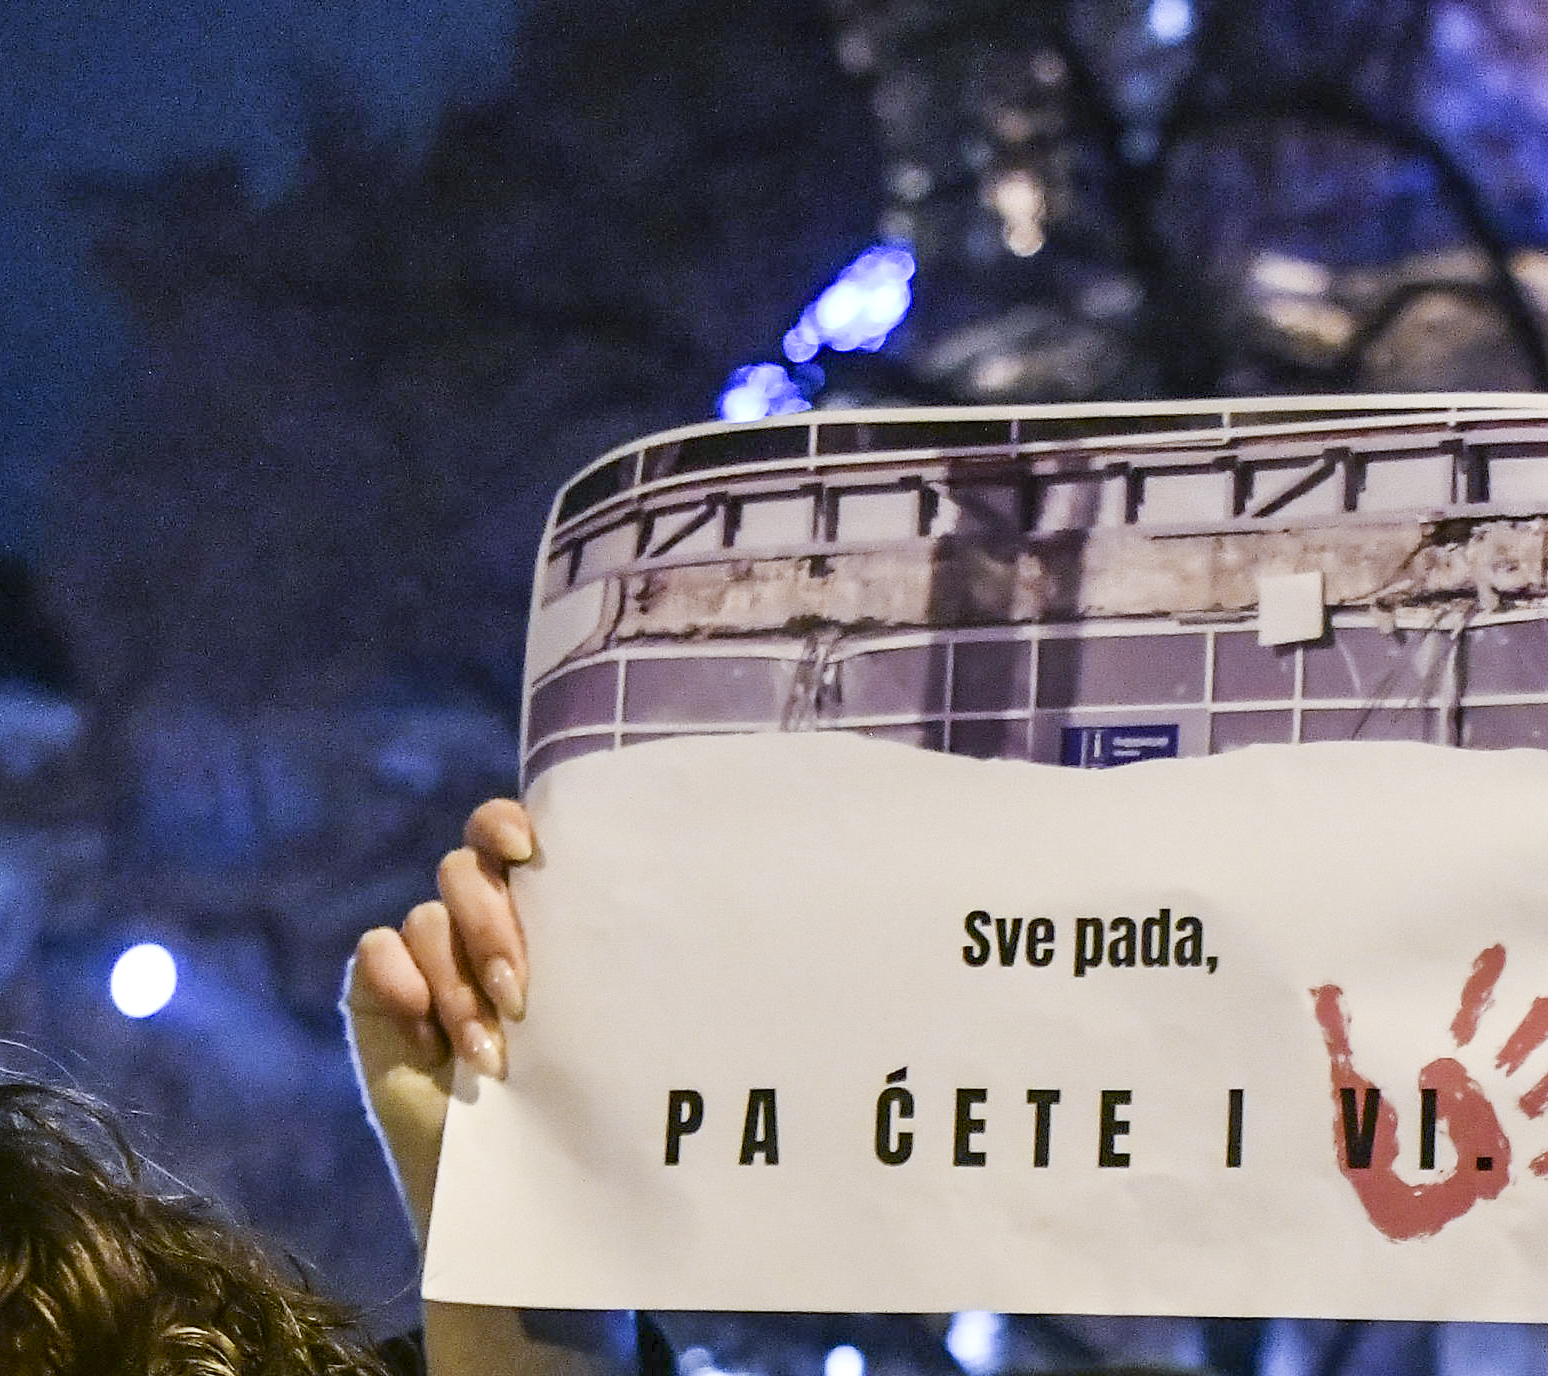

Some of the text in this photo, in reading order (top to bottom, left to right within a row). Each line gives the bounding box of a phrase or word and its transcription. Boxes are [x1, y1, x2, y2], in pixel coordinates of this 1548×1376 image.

[961, 907, 1220, 979] Sve pada,
[663, 1065, 1494, 1172] PA ĆETE I VI.
